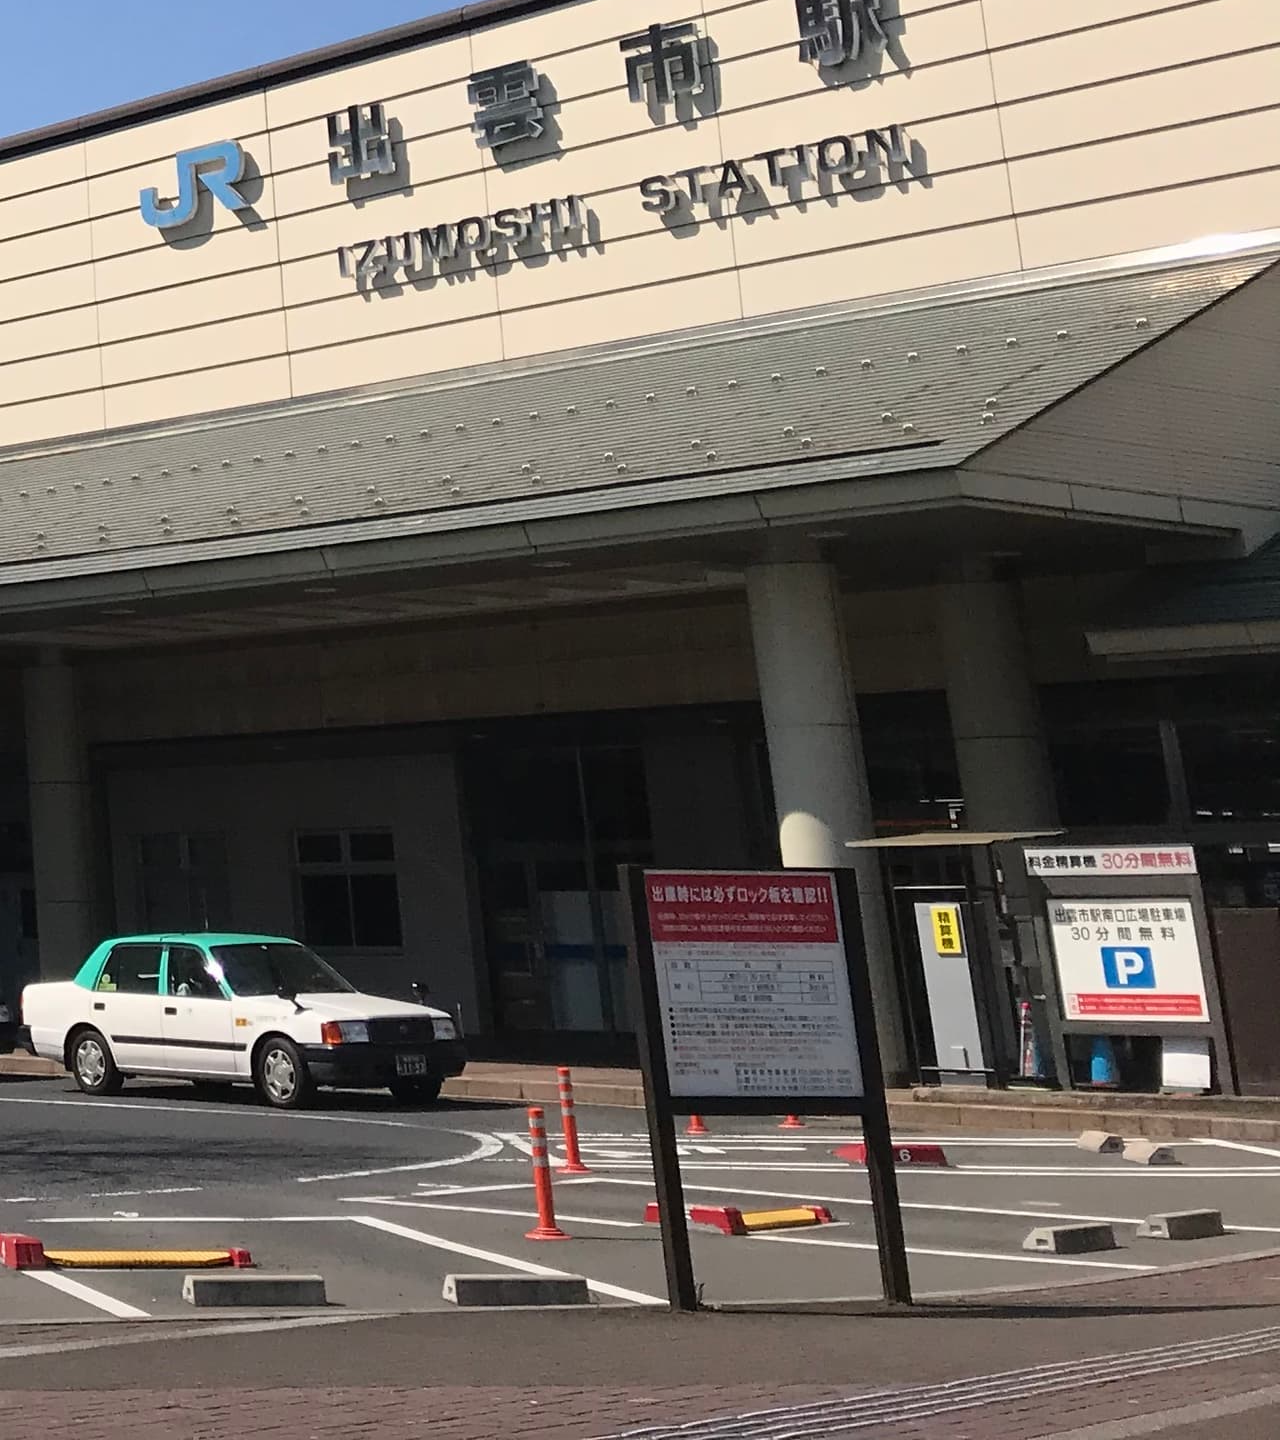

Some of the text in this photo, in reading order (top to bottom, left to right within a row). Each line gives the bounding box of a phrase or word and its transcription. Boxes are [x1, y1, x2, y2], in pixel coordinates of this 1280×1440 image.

[139, 139, 250, 230] JR
[338, 123, 914, 283] IZUMOSHI STATION
[1028, 853, 1192, 868] 料金精算機 30分間無料
[937, 912, 954, 949] 精算機
[1071, 927, 1175, 941] 30分間無料
[1114, 952, 1144, 984] P
[900, 1149, 911, 1161] 6
